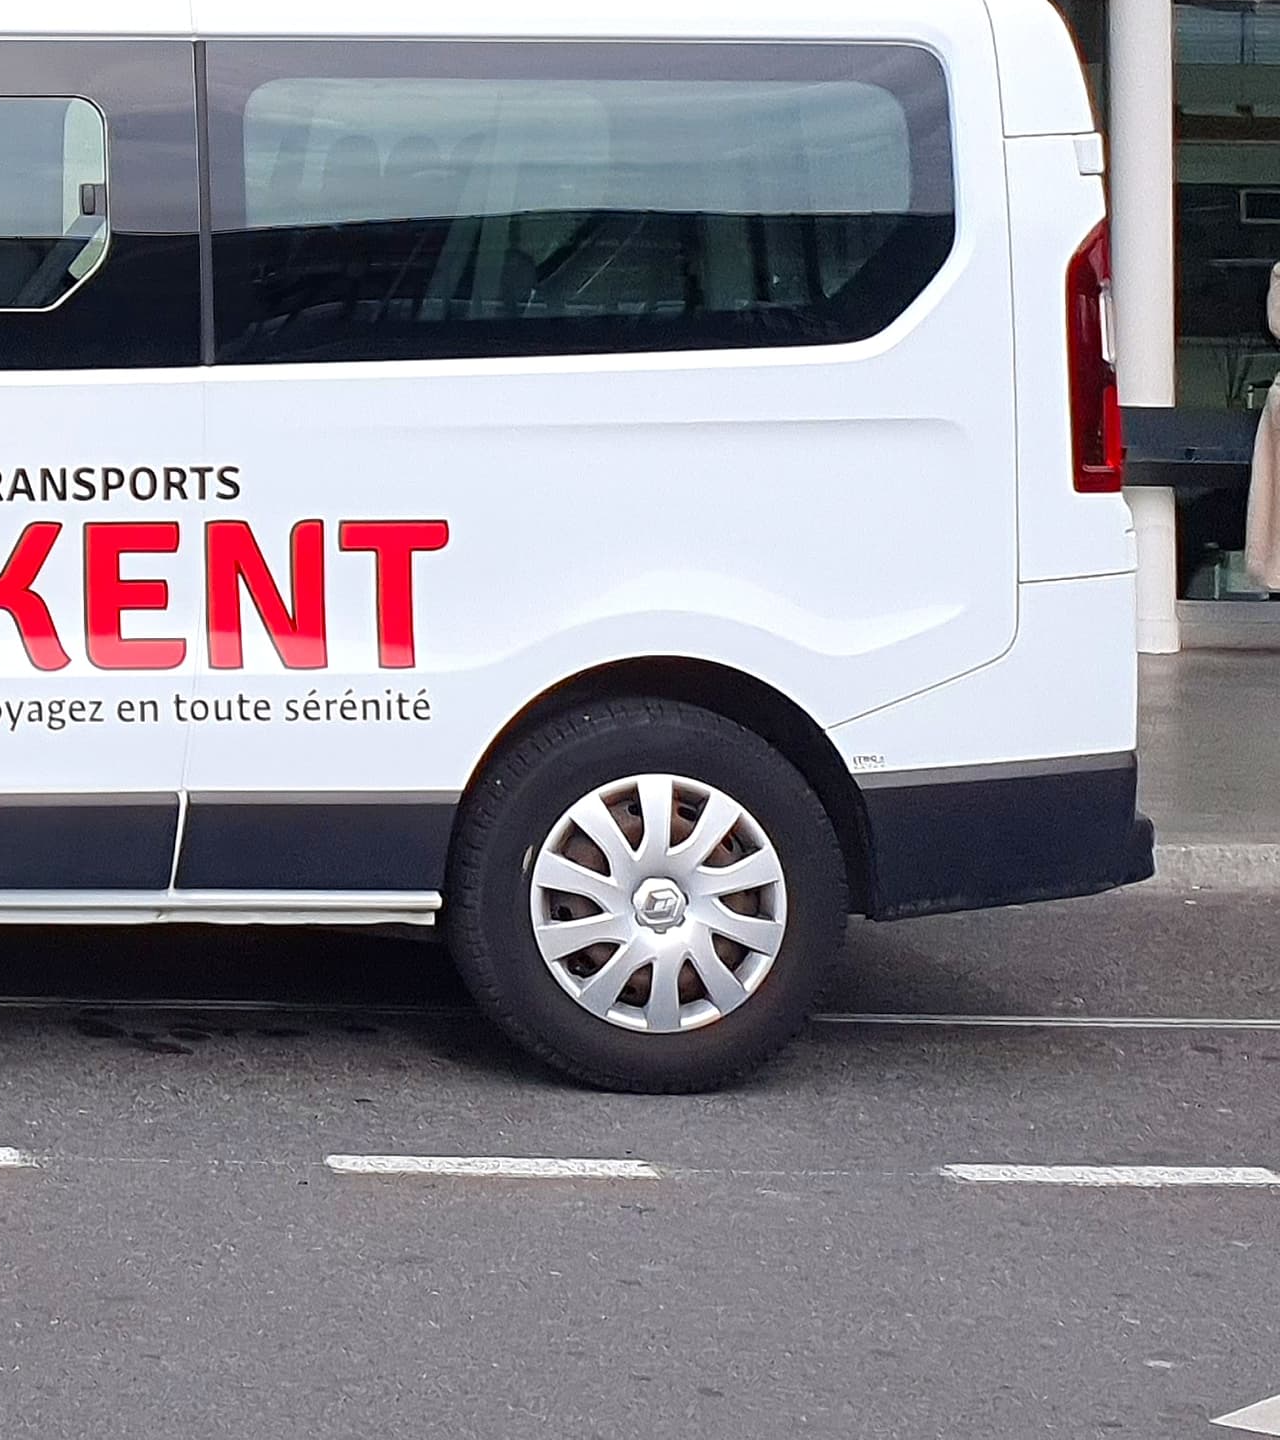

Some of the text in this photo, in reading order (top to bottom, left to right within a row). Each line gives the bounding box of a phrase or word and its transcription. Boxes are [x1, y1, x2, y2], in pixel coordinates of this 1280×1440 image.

[117, 700, 158, 722] en
[174, 694, 271, 721] toute
[285, 689, 430, 721] sérénité
